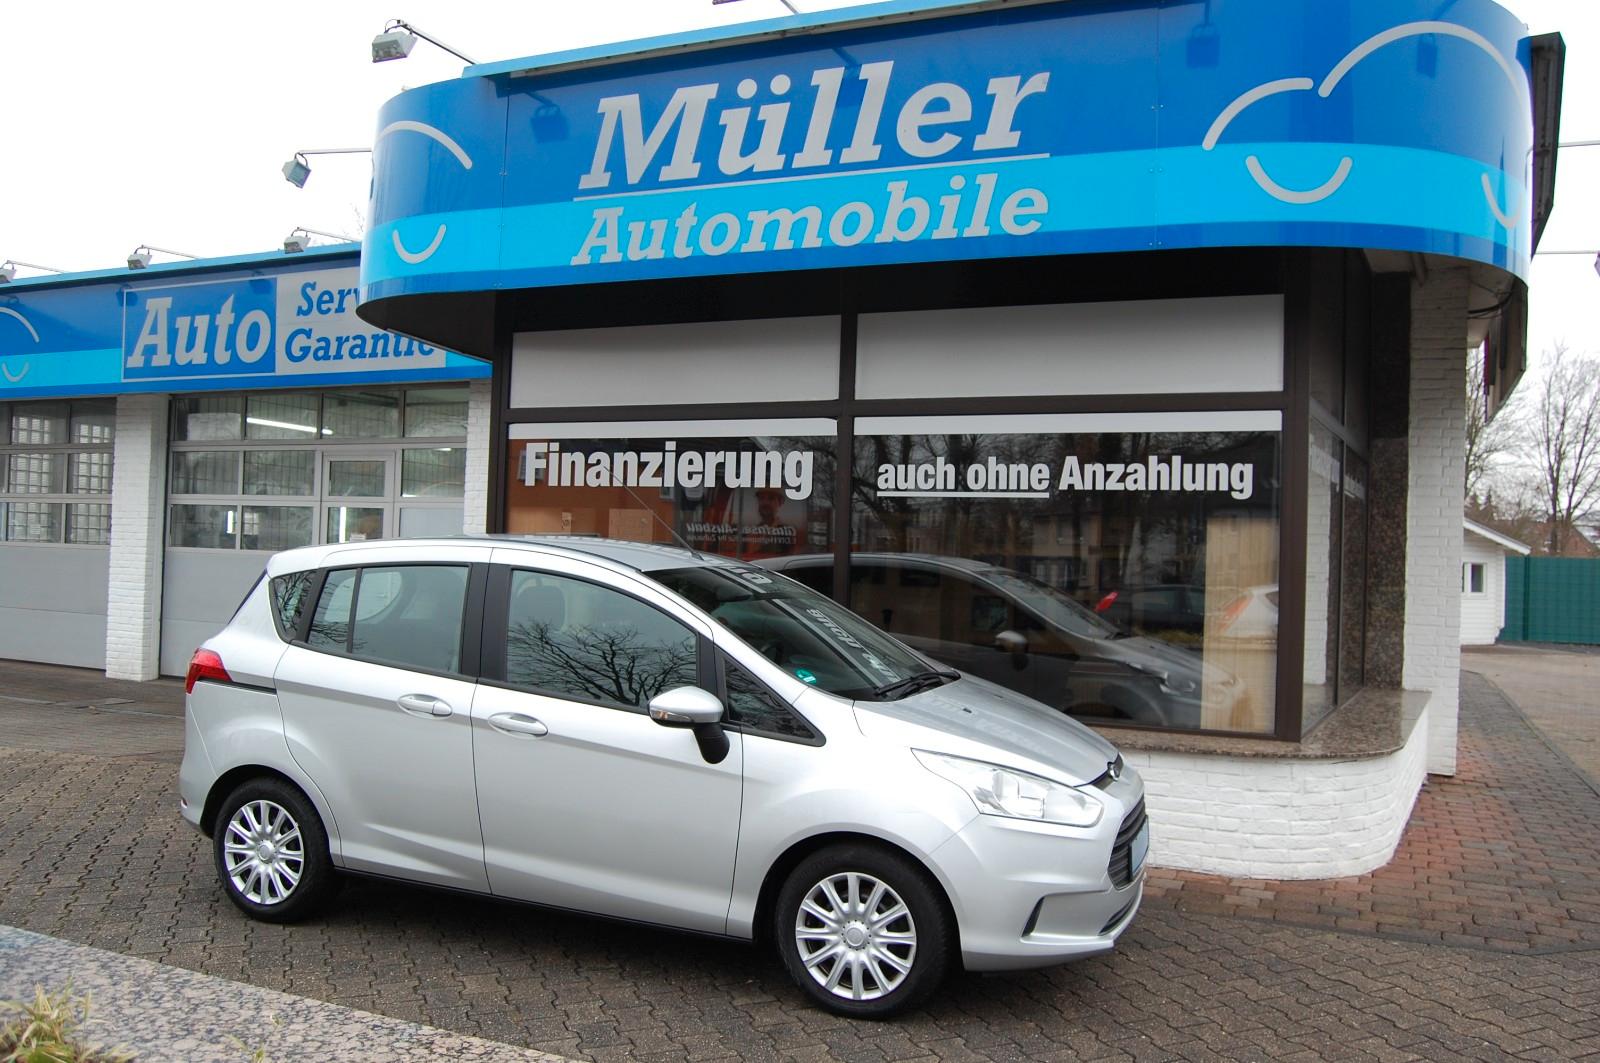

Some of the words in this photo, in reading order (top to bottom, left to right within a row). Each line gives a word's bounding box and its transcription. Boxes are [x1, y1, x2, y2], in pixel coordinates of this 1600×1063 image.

[578, 60, 1051, 190] Müller
[570, 172, 1050, 266] Automobile
[126, 293, 272, 369] Auto
[524, 441, 814, 500] Finanzierung
[877, 457, 956, 490] auch
[966, 456, 1050, 490] ohne
[1058, 455, 1254, 500] Anzahlung
